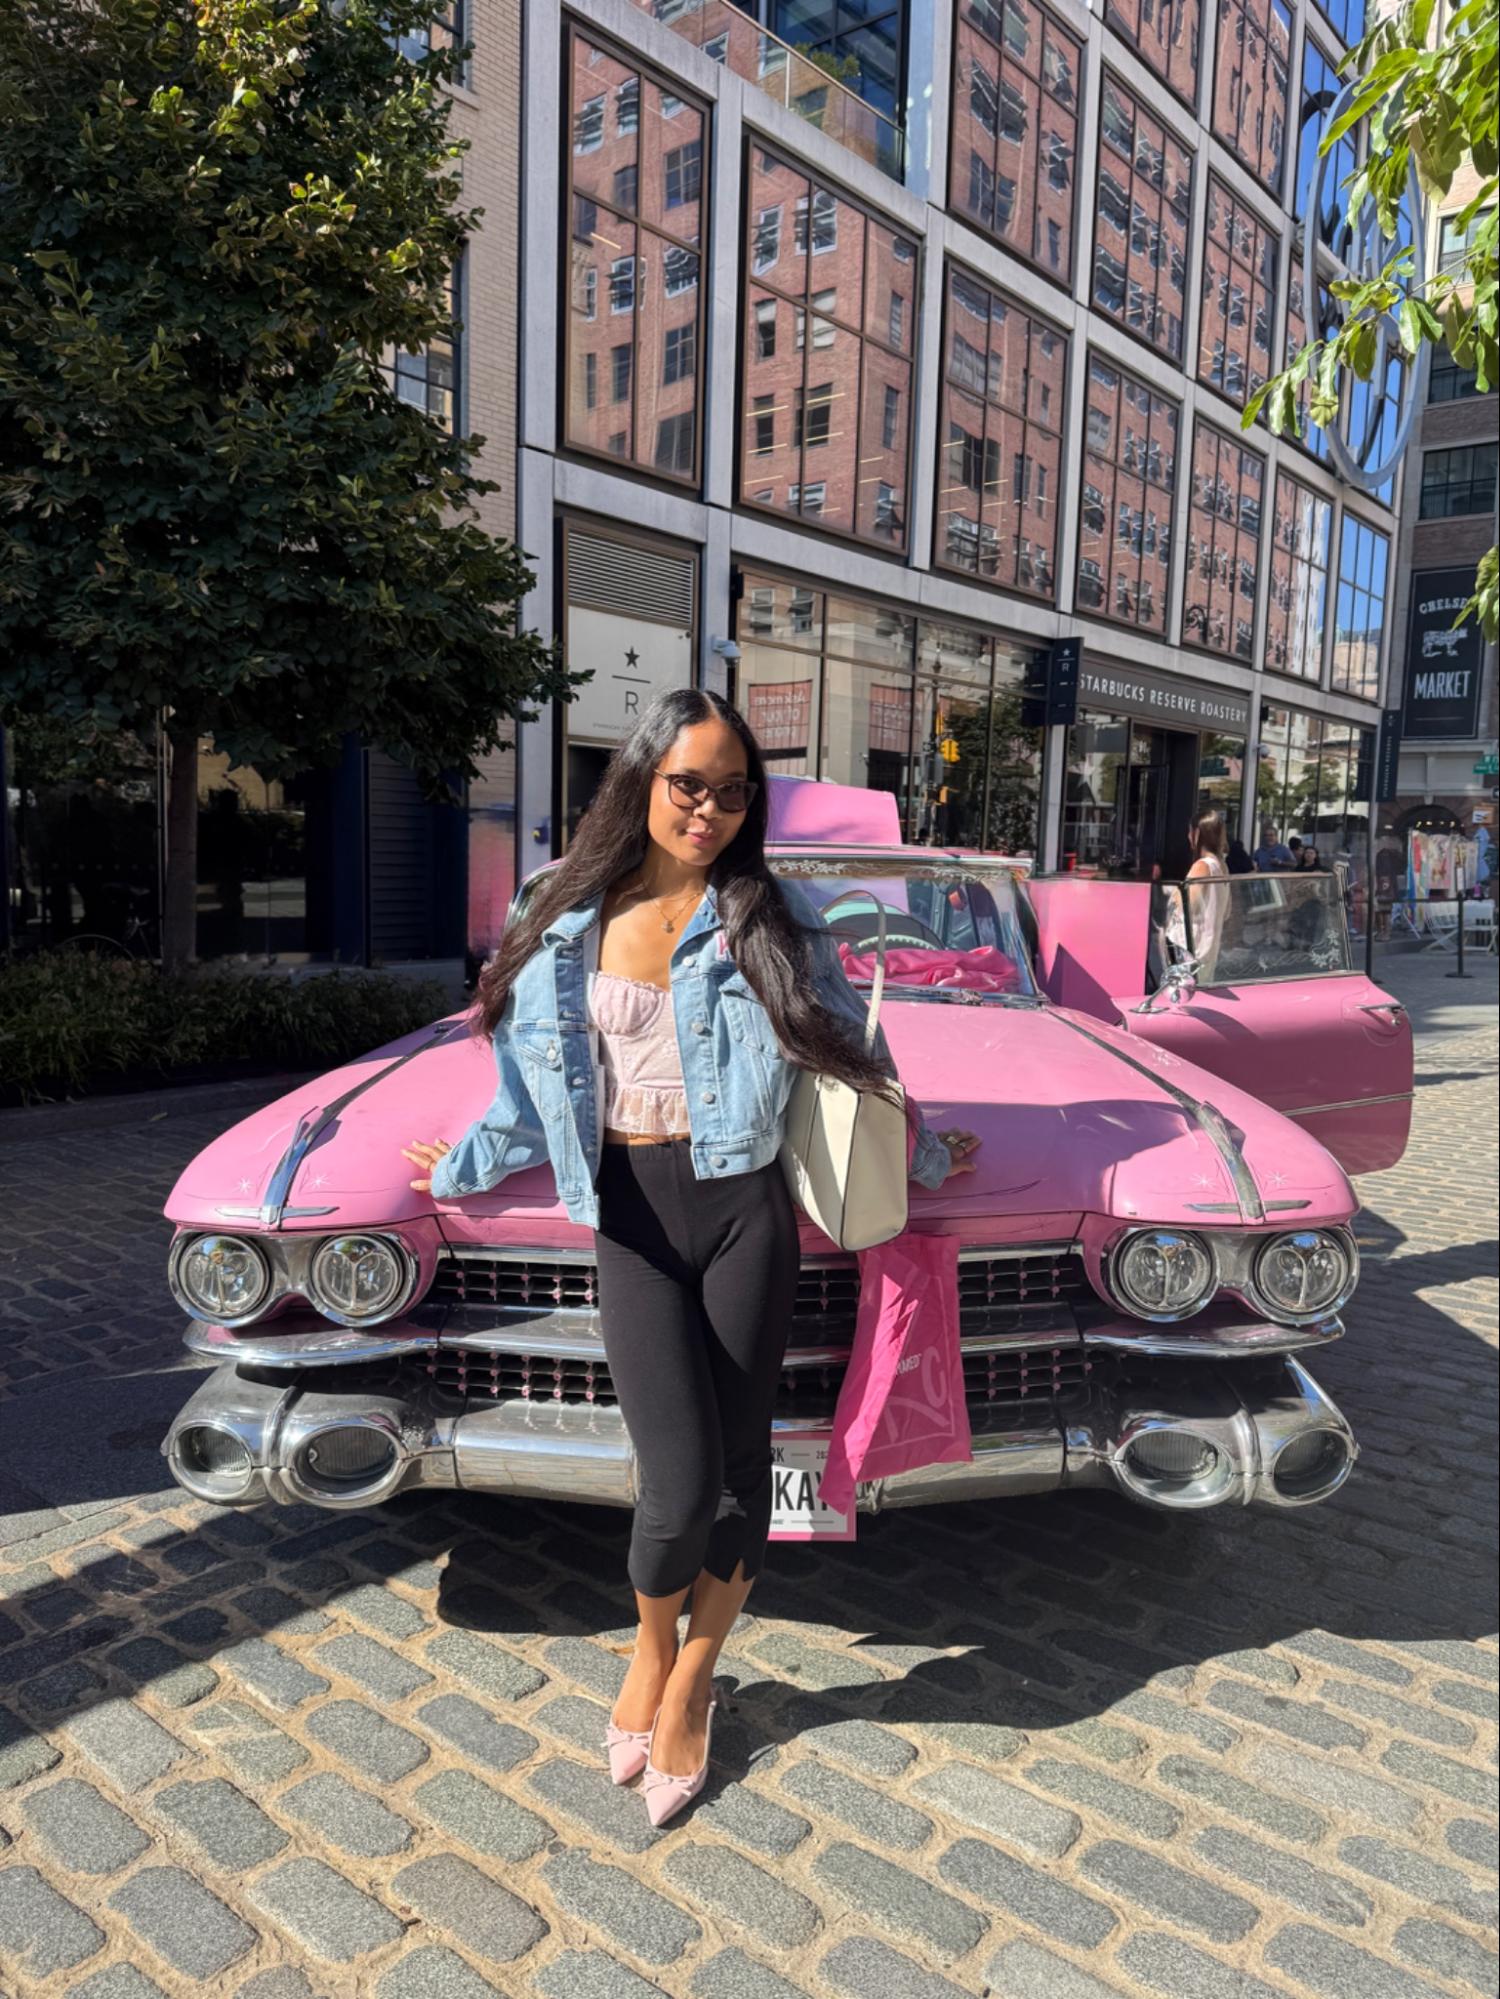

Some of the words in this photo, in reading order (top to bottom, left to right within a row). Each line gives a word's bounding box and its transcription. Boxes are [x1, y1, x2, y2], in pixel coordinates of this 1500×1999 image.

[1419, 597, 1468, 615] CHELSE
[1080, 673, 1145, 702] STARBUCKS
[1150, 690, 1197, 713] RESERVE
[1200, 701, 1248, 723] ROASTERY
[1414, 671, 1471, 700] MARKET
[625, 690, 639, 716] R
[771, 1447, 785, 1463] RK
